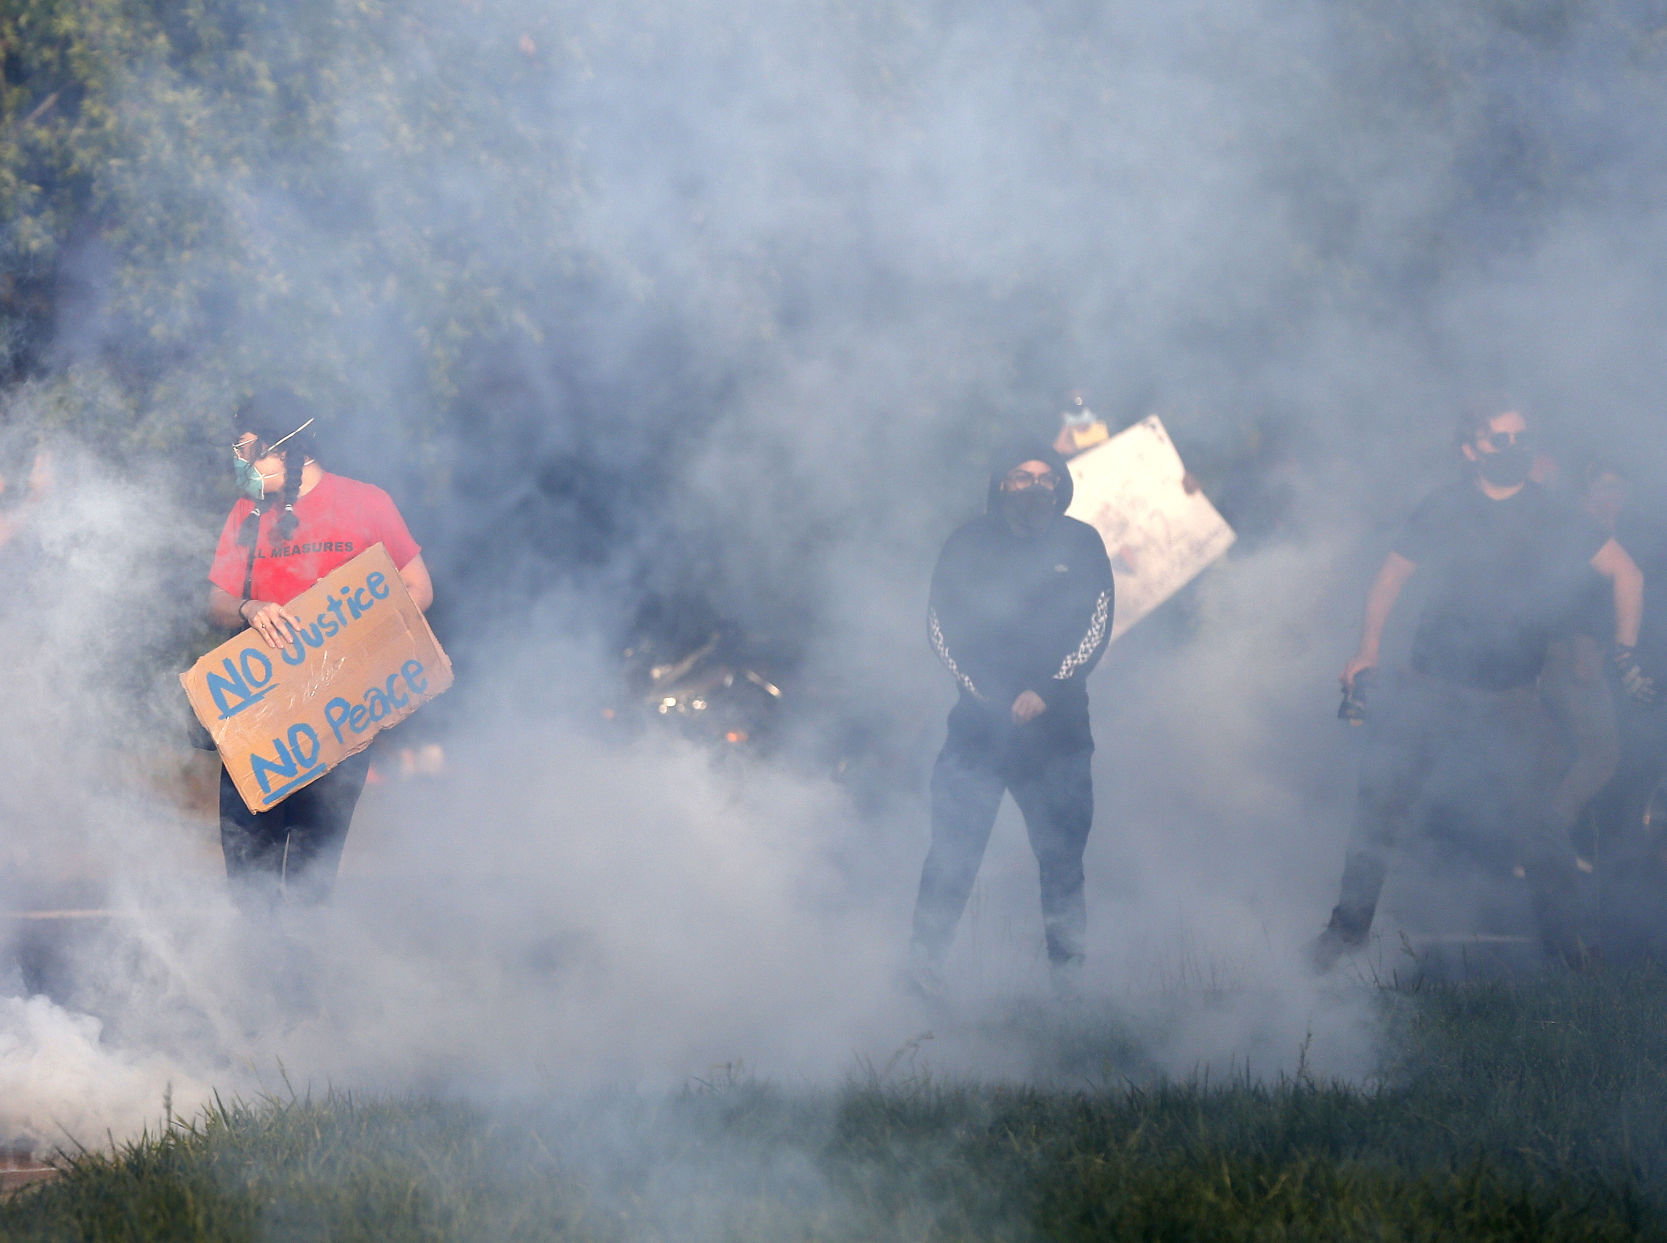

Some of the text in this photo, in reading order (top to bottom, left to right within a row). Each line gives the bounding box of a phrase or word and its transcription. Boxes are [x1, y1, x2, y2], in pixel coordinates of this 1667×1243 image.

[271, 541, 354, 558] MEASURES
[206, 571, 390, 718] NO Justice
[250, 659, 428, 802] NO Peace
